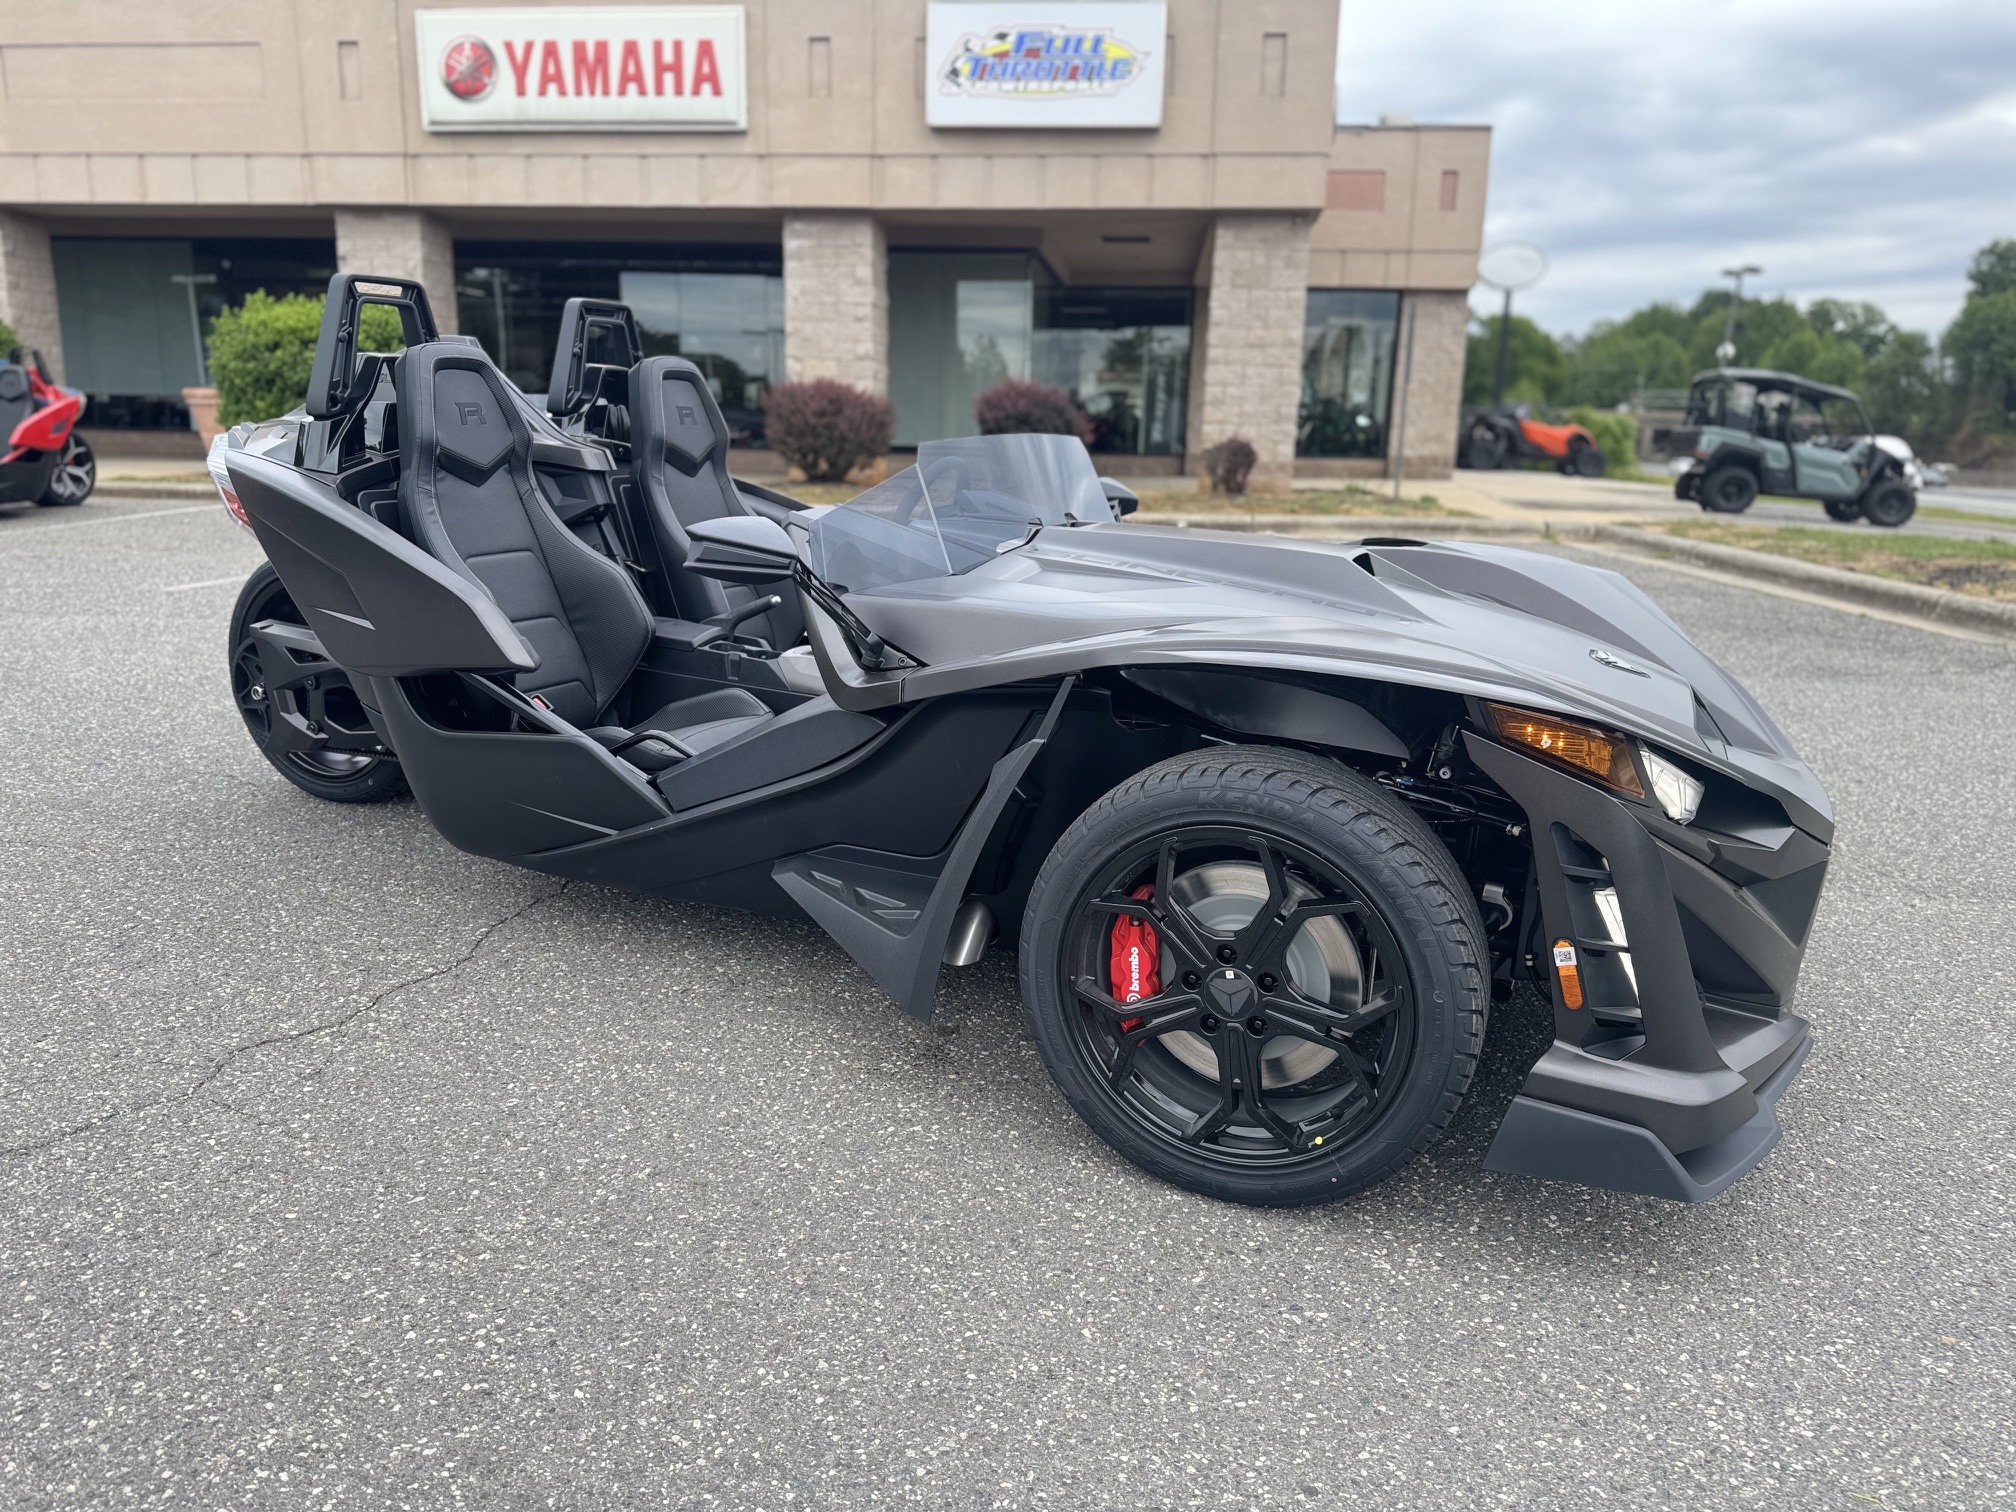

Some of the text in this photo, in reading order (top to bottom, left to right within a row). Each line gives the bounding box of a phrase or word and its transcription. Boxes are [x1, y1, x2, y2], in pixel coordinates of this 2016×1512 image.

[503, 39, 722, 97] YAMAHA
[965, 54, 1134, 81] THROTTLE
[453, 402, 487, 426] R
[675, 405, 698, 426] R
[1198, 788, 1315, 833] KENDA
[1128, 946, 1140, 992] brembo
